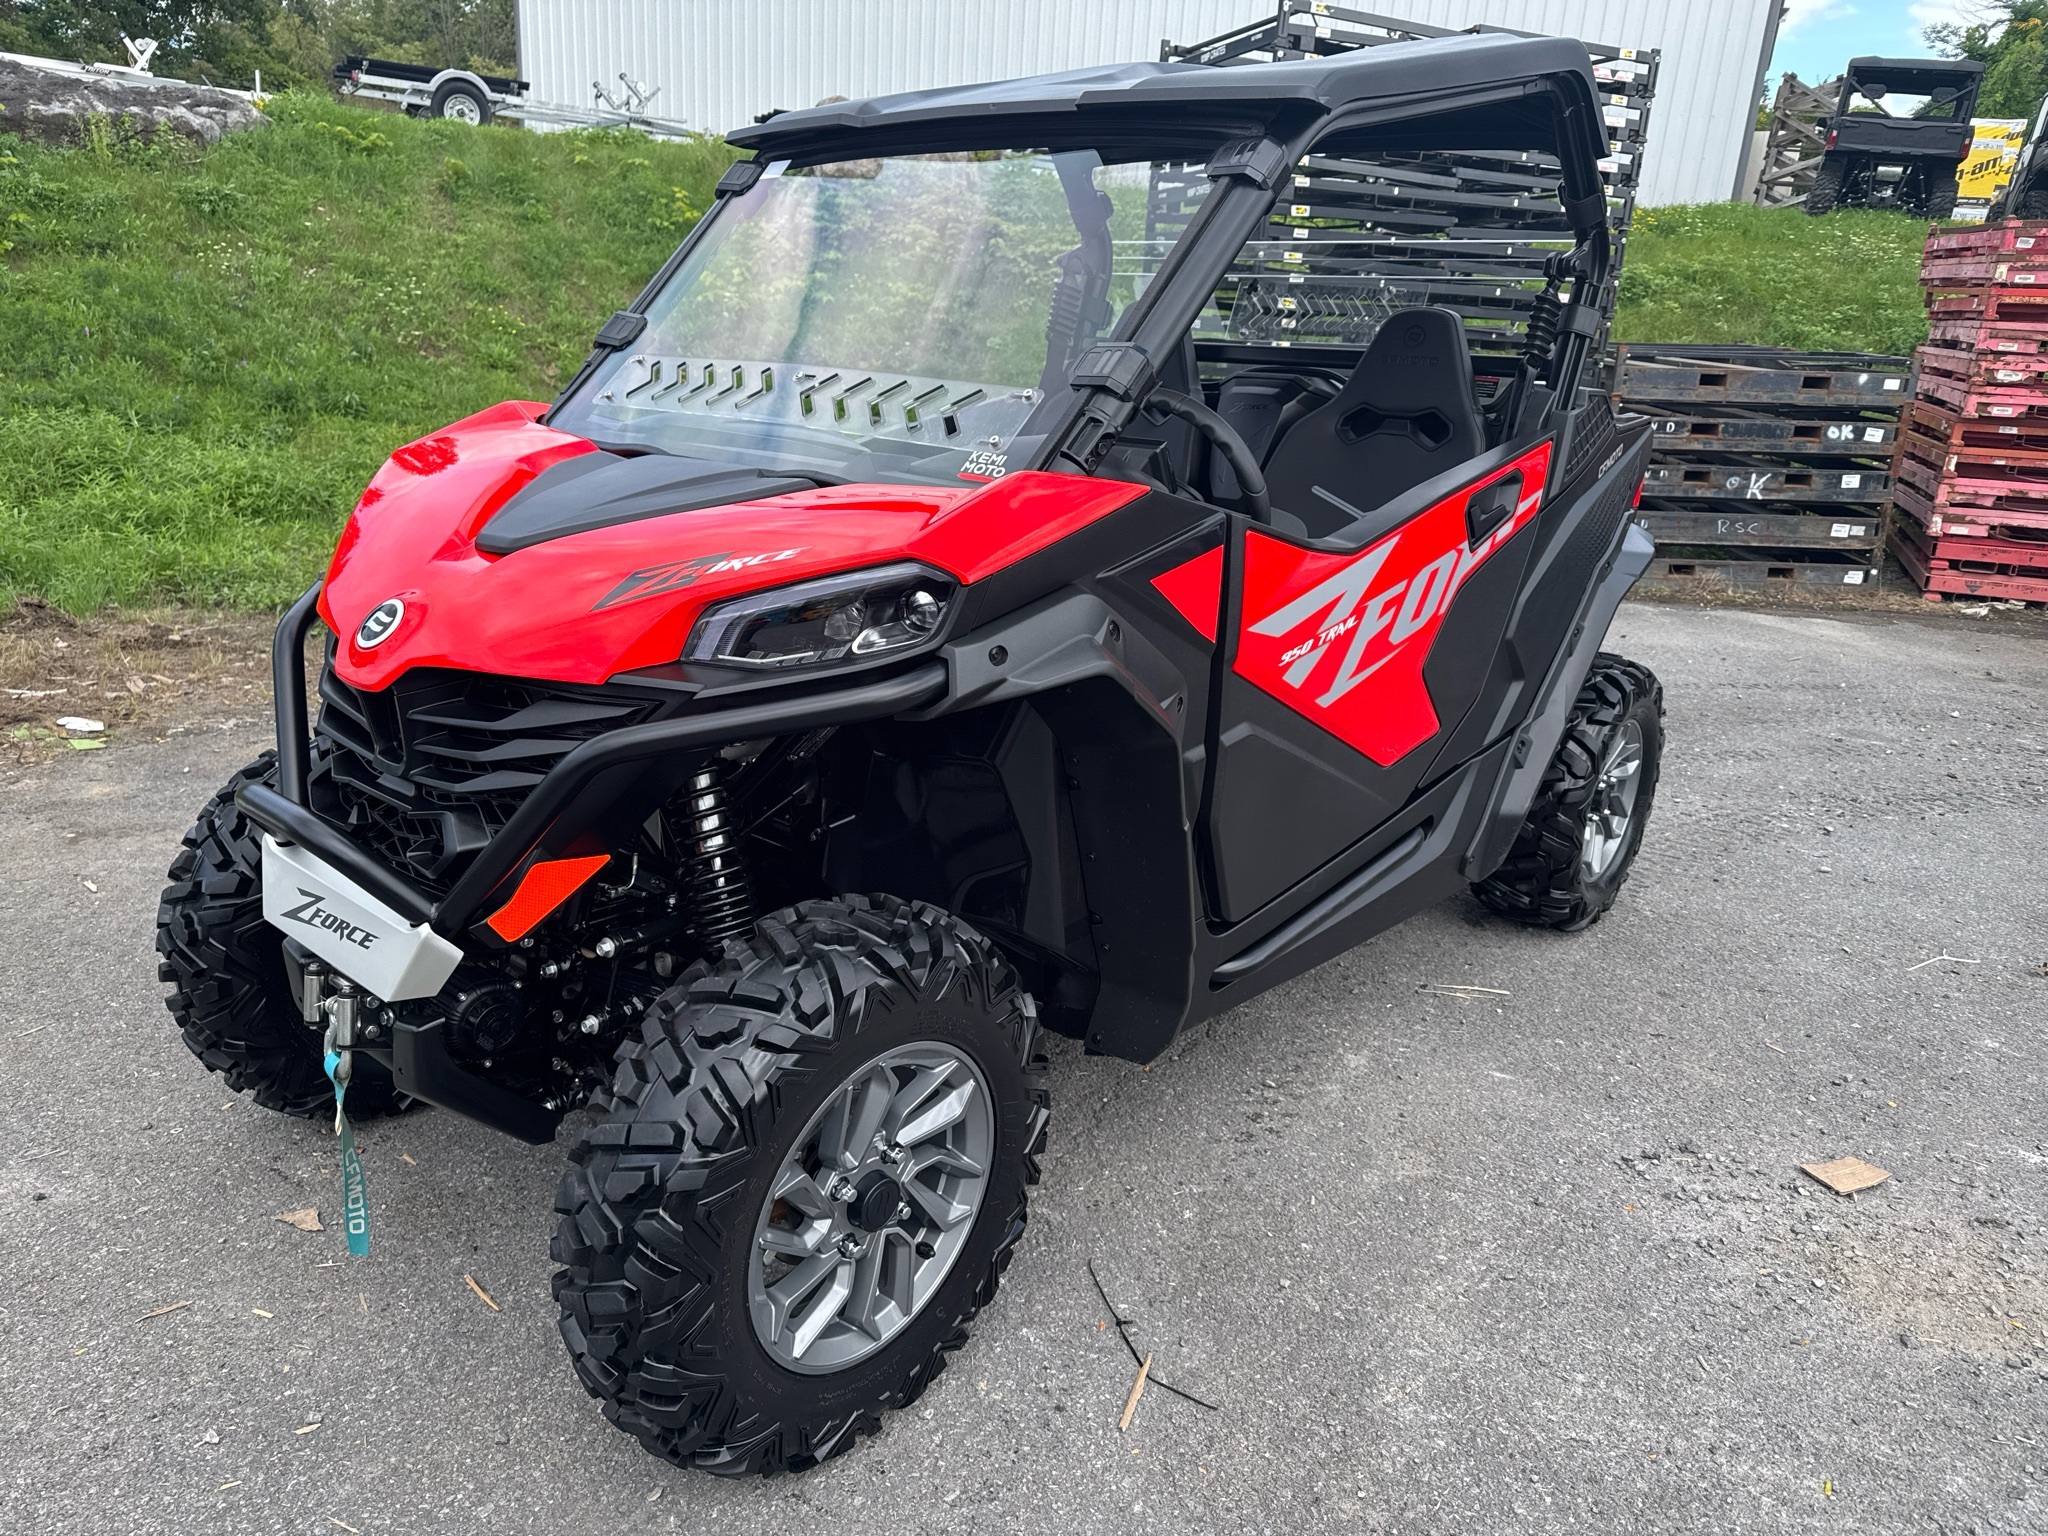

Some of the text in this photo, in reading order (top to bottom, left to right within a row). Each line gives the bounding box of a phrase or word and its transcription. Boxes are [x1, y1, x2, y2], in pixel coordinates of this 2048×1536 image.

[1827, 424, 1854, 441] OK
[960, 461, 1006, 478] MOTO
[968, 450, 1008, 466] KEMI
[1598, 442, 1624, 479] CFMOTO
[1278, 614, 1359, 667] 950 TRAIL
[280, 886, 381, 951] ZFORCE
[345, 1147, 366, 1234] CFMOTO
